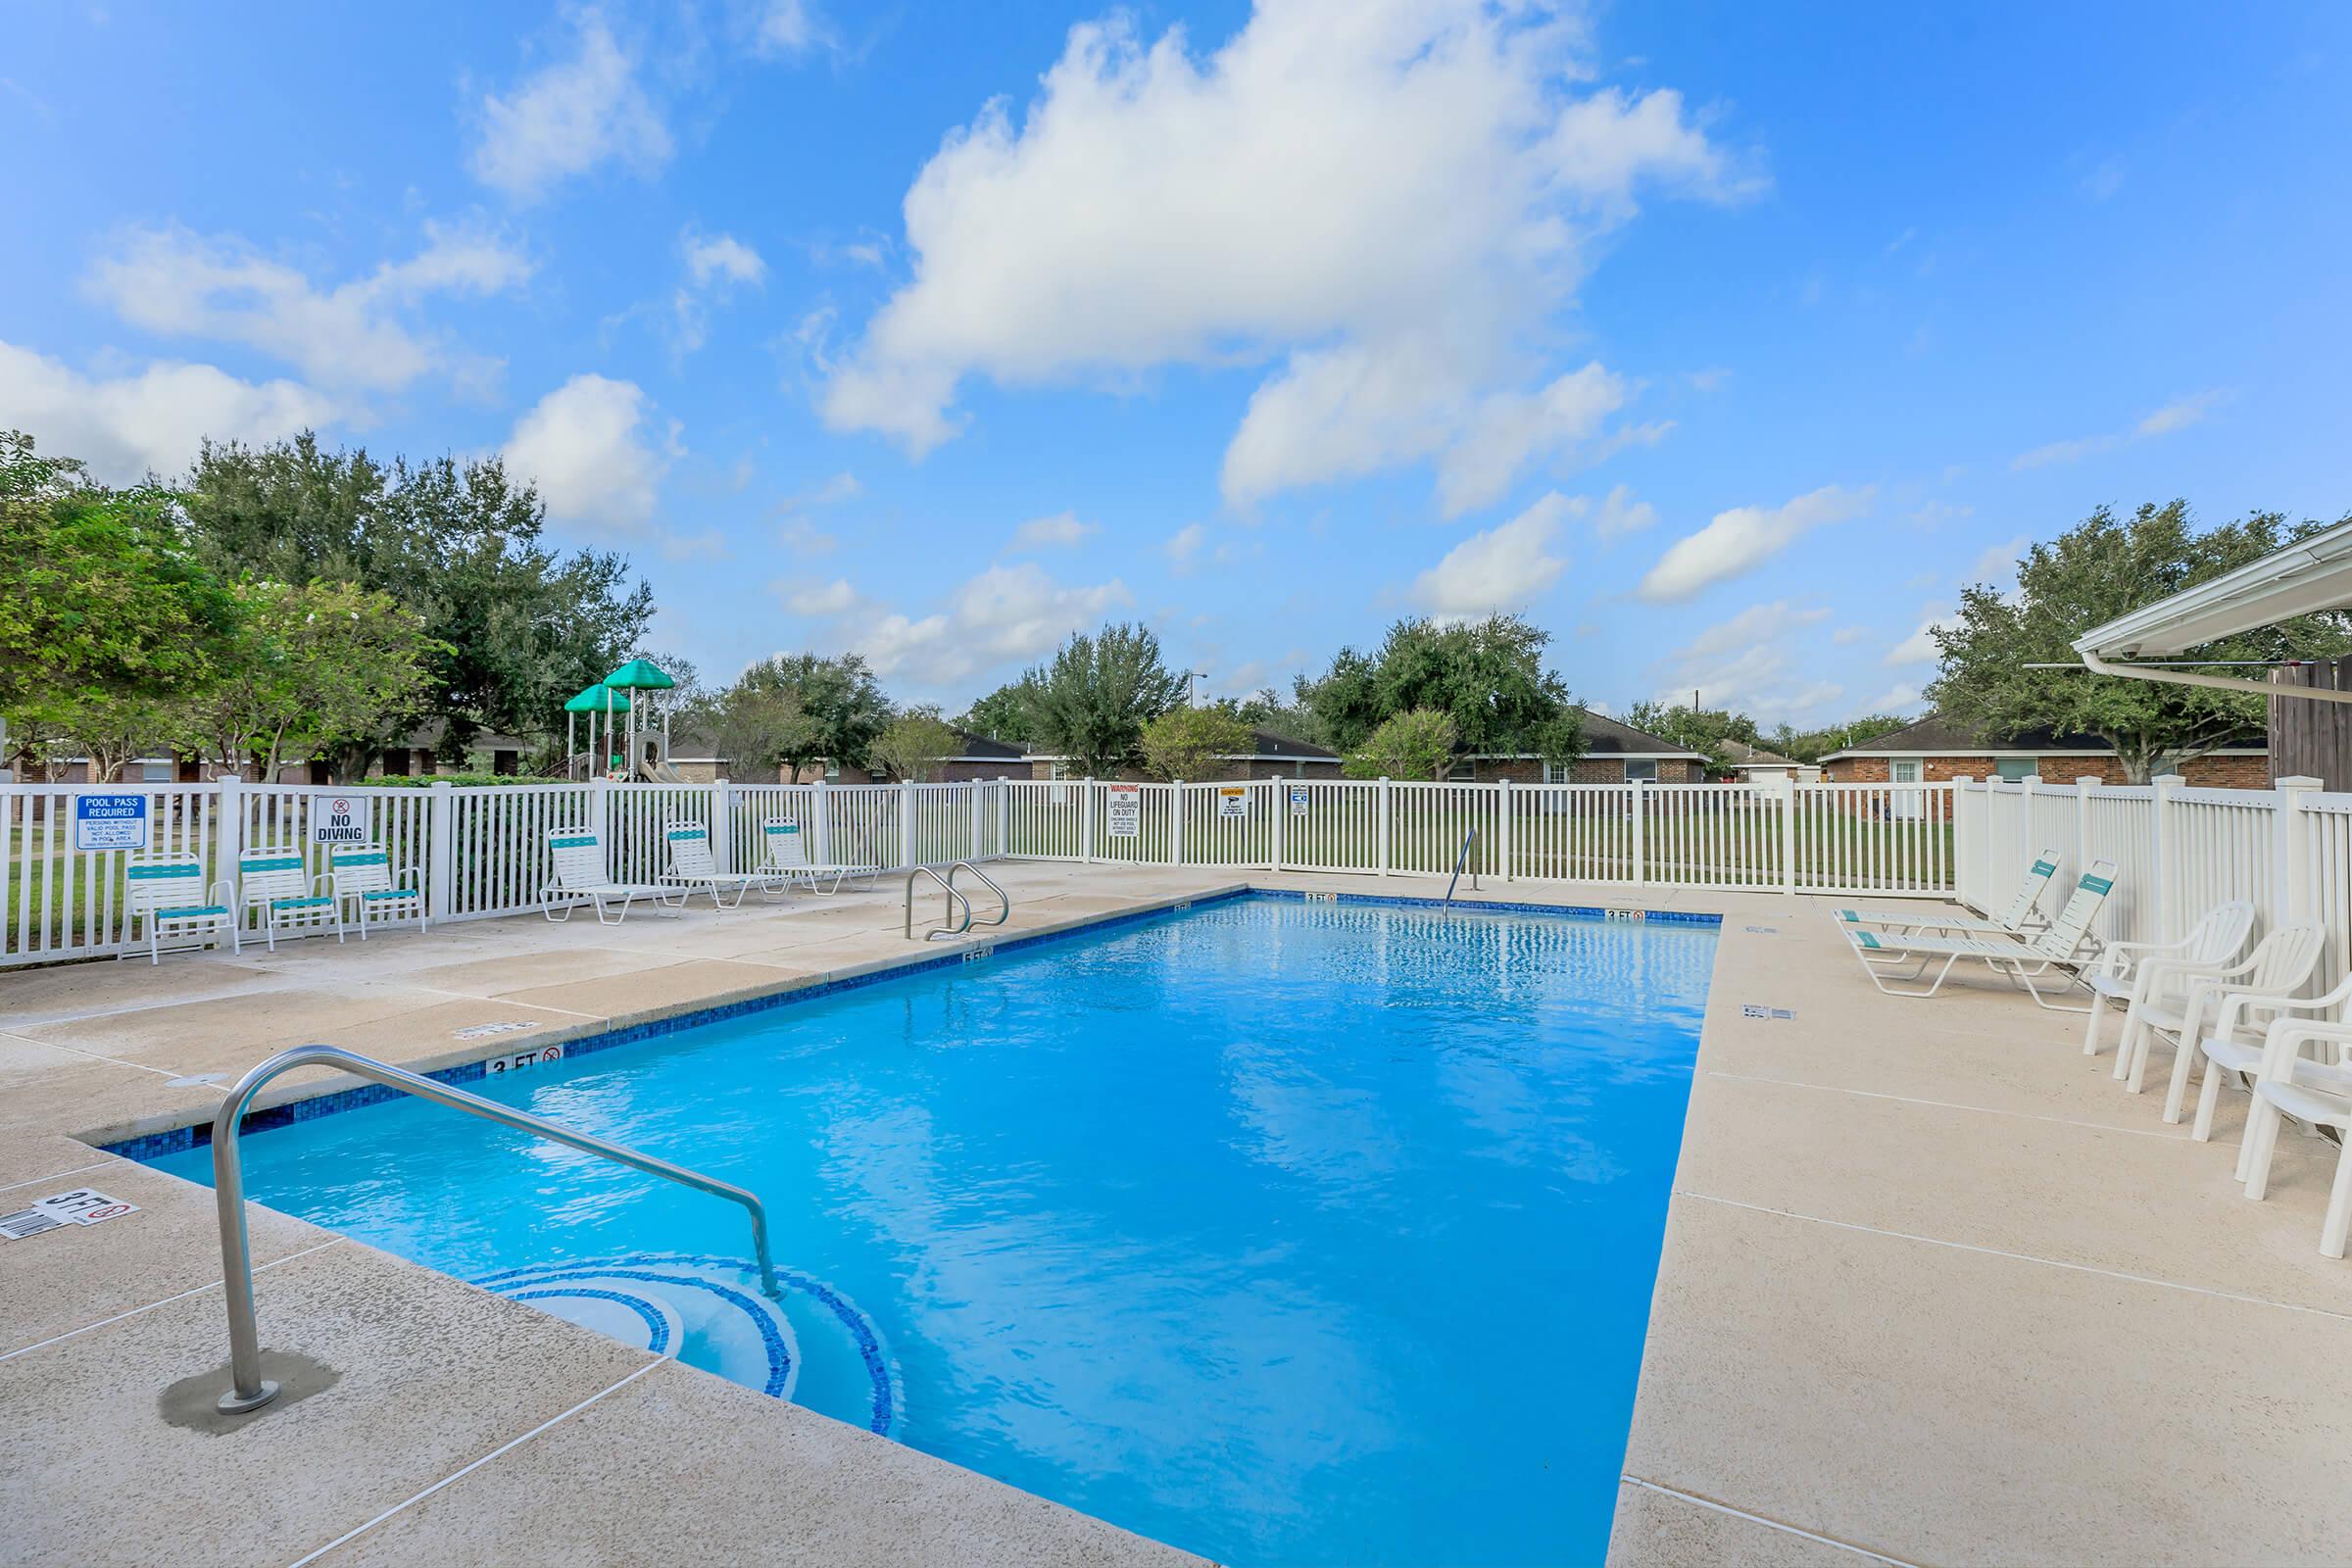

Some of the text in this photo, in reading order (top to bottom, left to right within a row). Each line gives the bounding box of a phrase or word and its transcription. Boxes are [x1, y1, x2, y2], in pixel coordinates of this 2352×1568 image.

[85, 798, 138, 807] POOL PASS
[89, 808, 135, 816] REQUIRED
[330, 814, 351, 827] NO
[318, 827, 362, 840] DIVING
[494, 1053, 537, 1074] 3 FT
[45, 1192, 113, 1214] 3 FT
